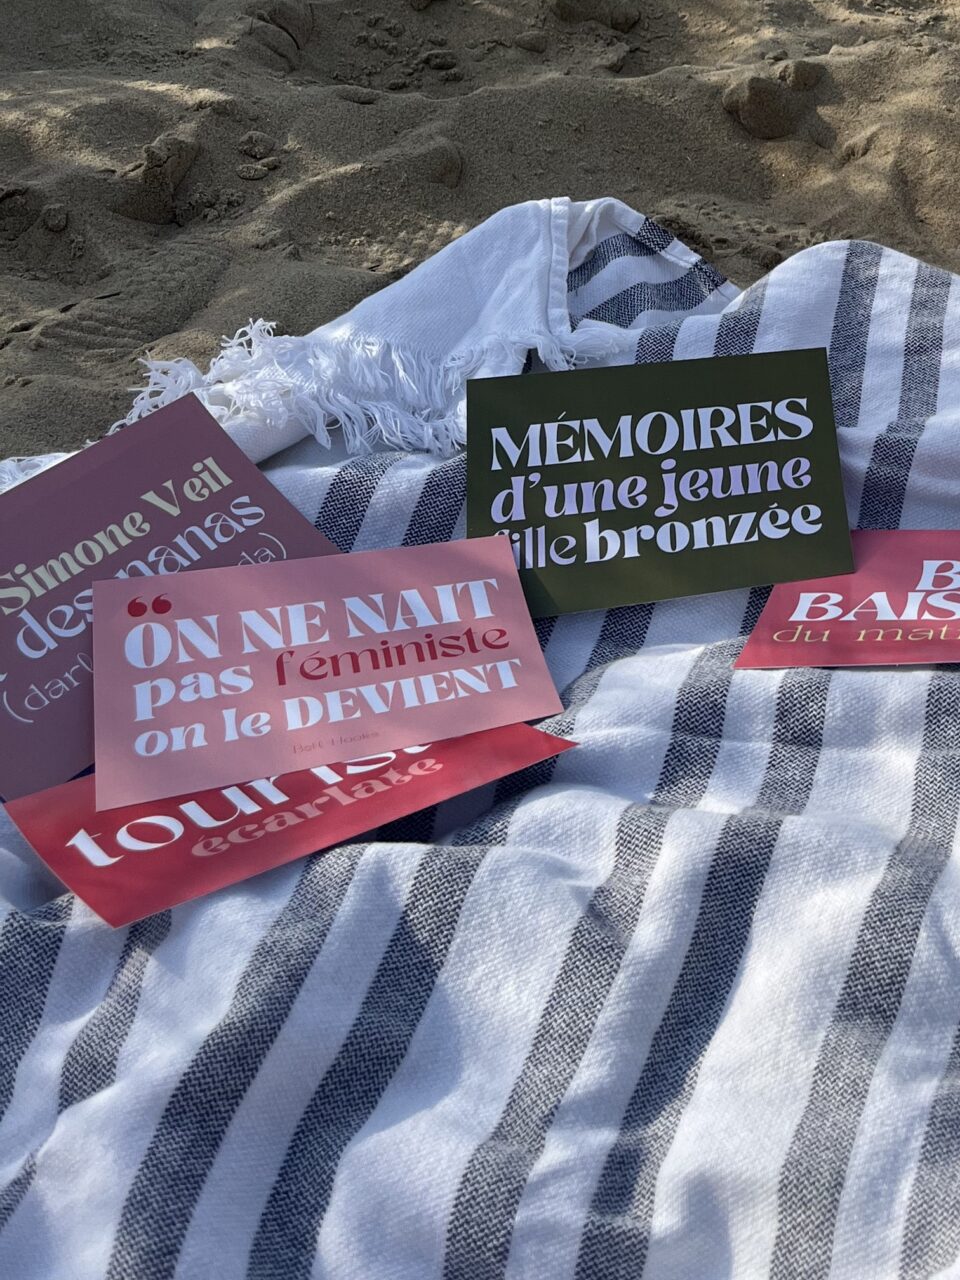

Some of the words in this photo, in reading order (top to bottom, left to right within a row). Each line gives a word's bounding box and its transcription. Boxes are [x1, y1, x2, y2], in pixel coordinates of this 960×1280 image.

[491, 397, 814, 470] MÉMOIRES
[491, 472, 648, 524] d'une
[654, 457, 812, 519] jeune
[0, 511, 151, 615] Simone
[140, 456, 233, 517] Veil
[115, 495, 266, 578] nanas
[493, 525, 577, 570] ille
[584, 502, 823, 564] bronzée
[239, 596, 330, 655] NE
[334, 578, 498, 632] NAIT
[773, 623, 830, 642] du
[133, 665, 254, 721] pas
[277, 626, 510, 686] féministe
[134, 721, 208, 757] on
[225, 705, 271, 742] le
[284, 658, 521, 731] DEVIENT
[192, 758, 444, 858] écarlate
